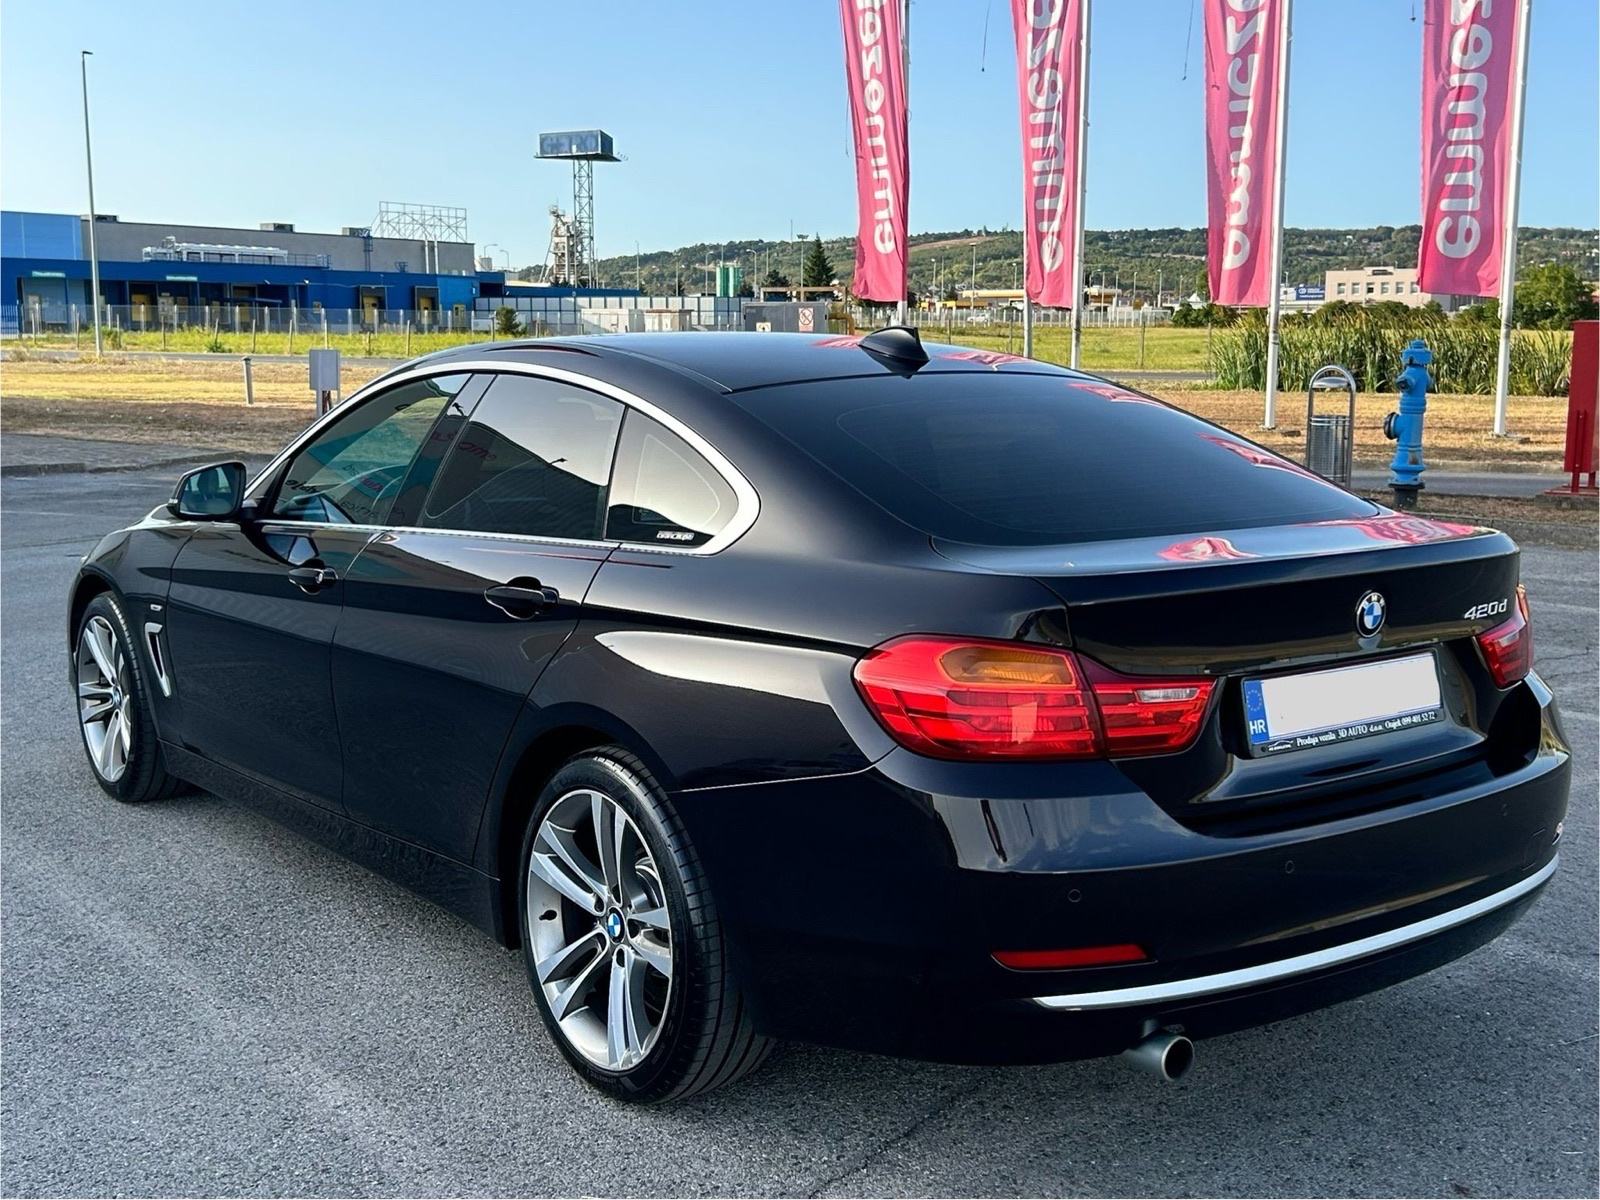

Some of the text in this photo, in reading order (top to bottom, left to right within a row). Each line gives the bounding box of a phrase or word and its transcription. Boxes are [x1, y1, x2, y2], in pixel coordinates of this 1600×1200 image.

[1463, 598, 1508, 620] 420d
[1248, 719, 1267, 735] HR
[1348, 724, 1368, 737] AUTO
